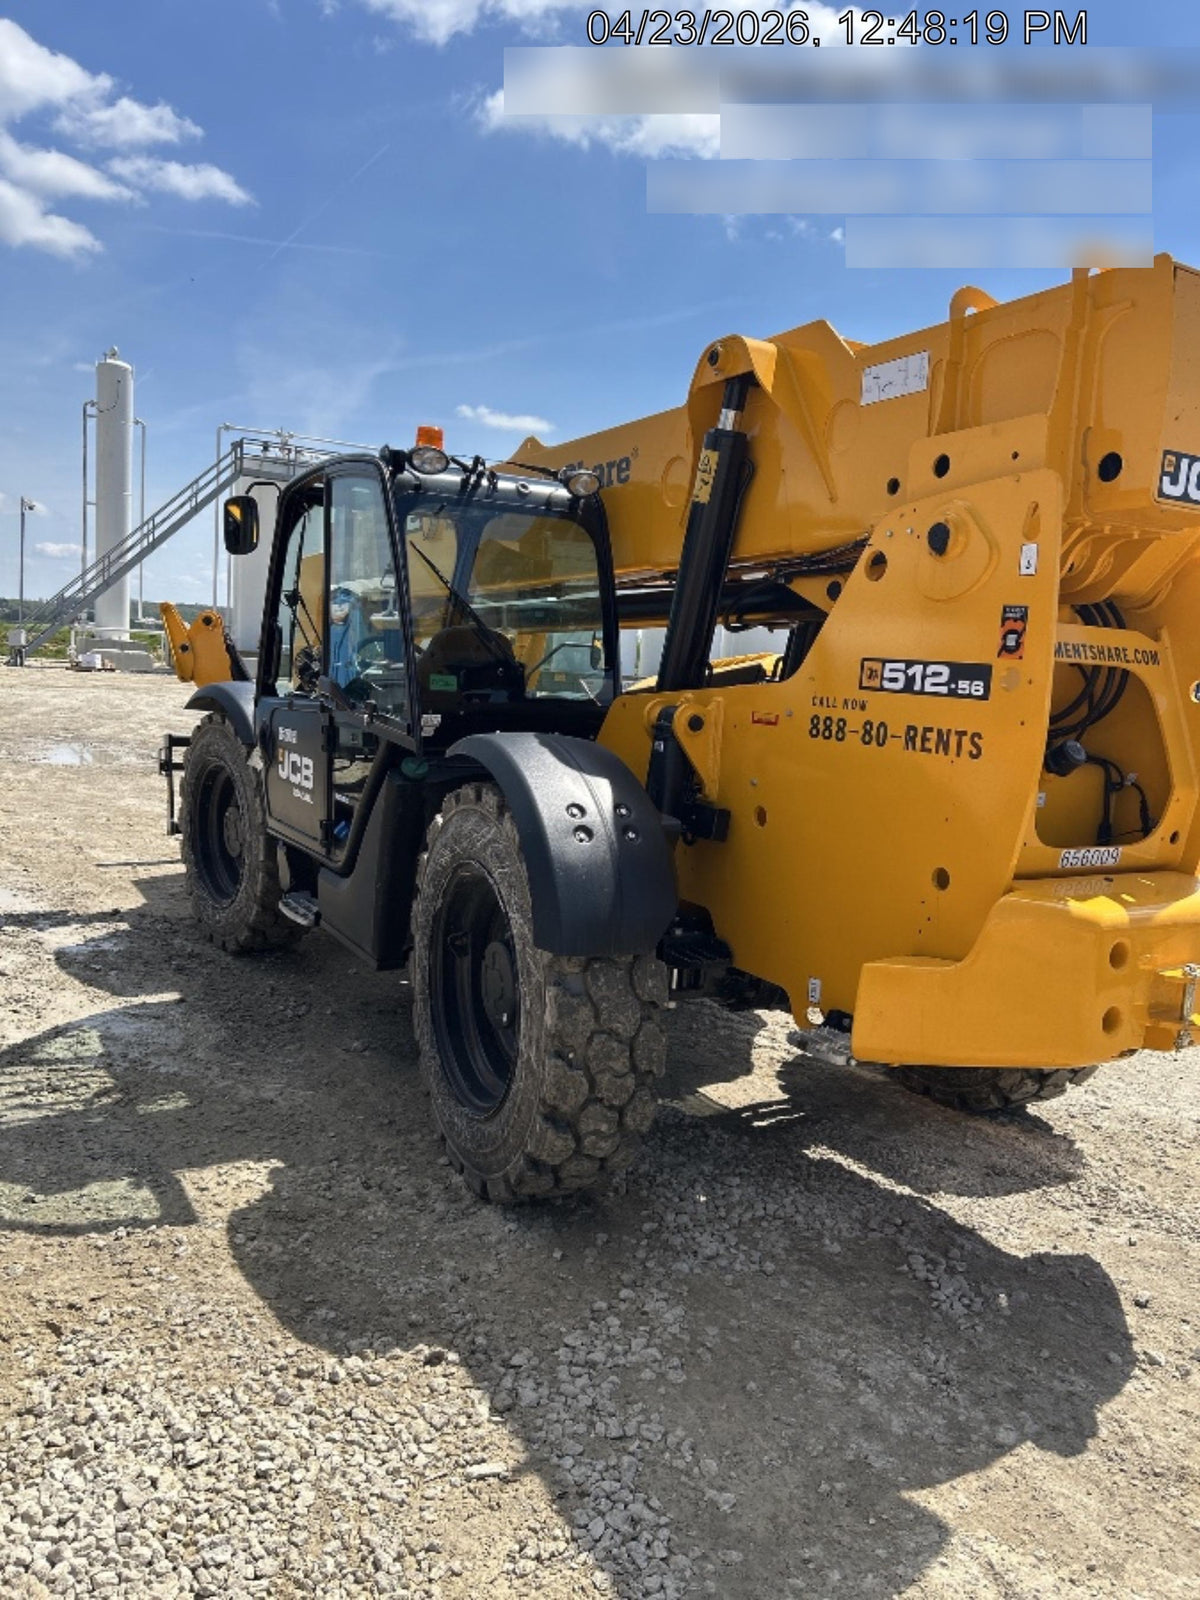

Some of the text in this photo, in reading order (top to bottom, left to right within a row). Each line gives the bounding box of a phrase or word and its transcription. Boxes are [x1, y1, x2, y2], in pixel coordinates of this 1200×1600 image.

[811, 695, 869, 712] CALL NOW
[808, 713, 984, 760] 888-80-RENTS
[278, 748, 314, 790] JCB
